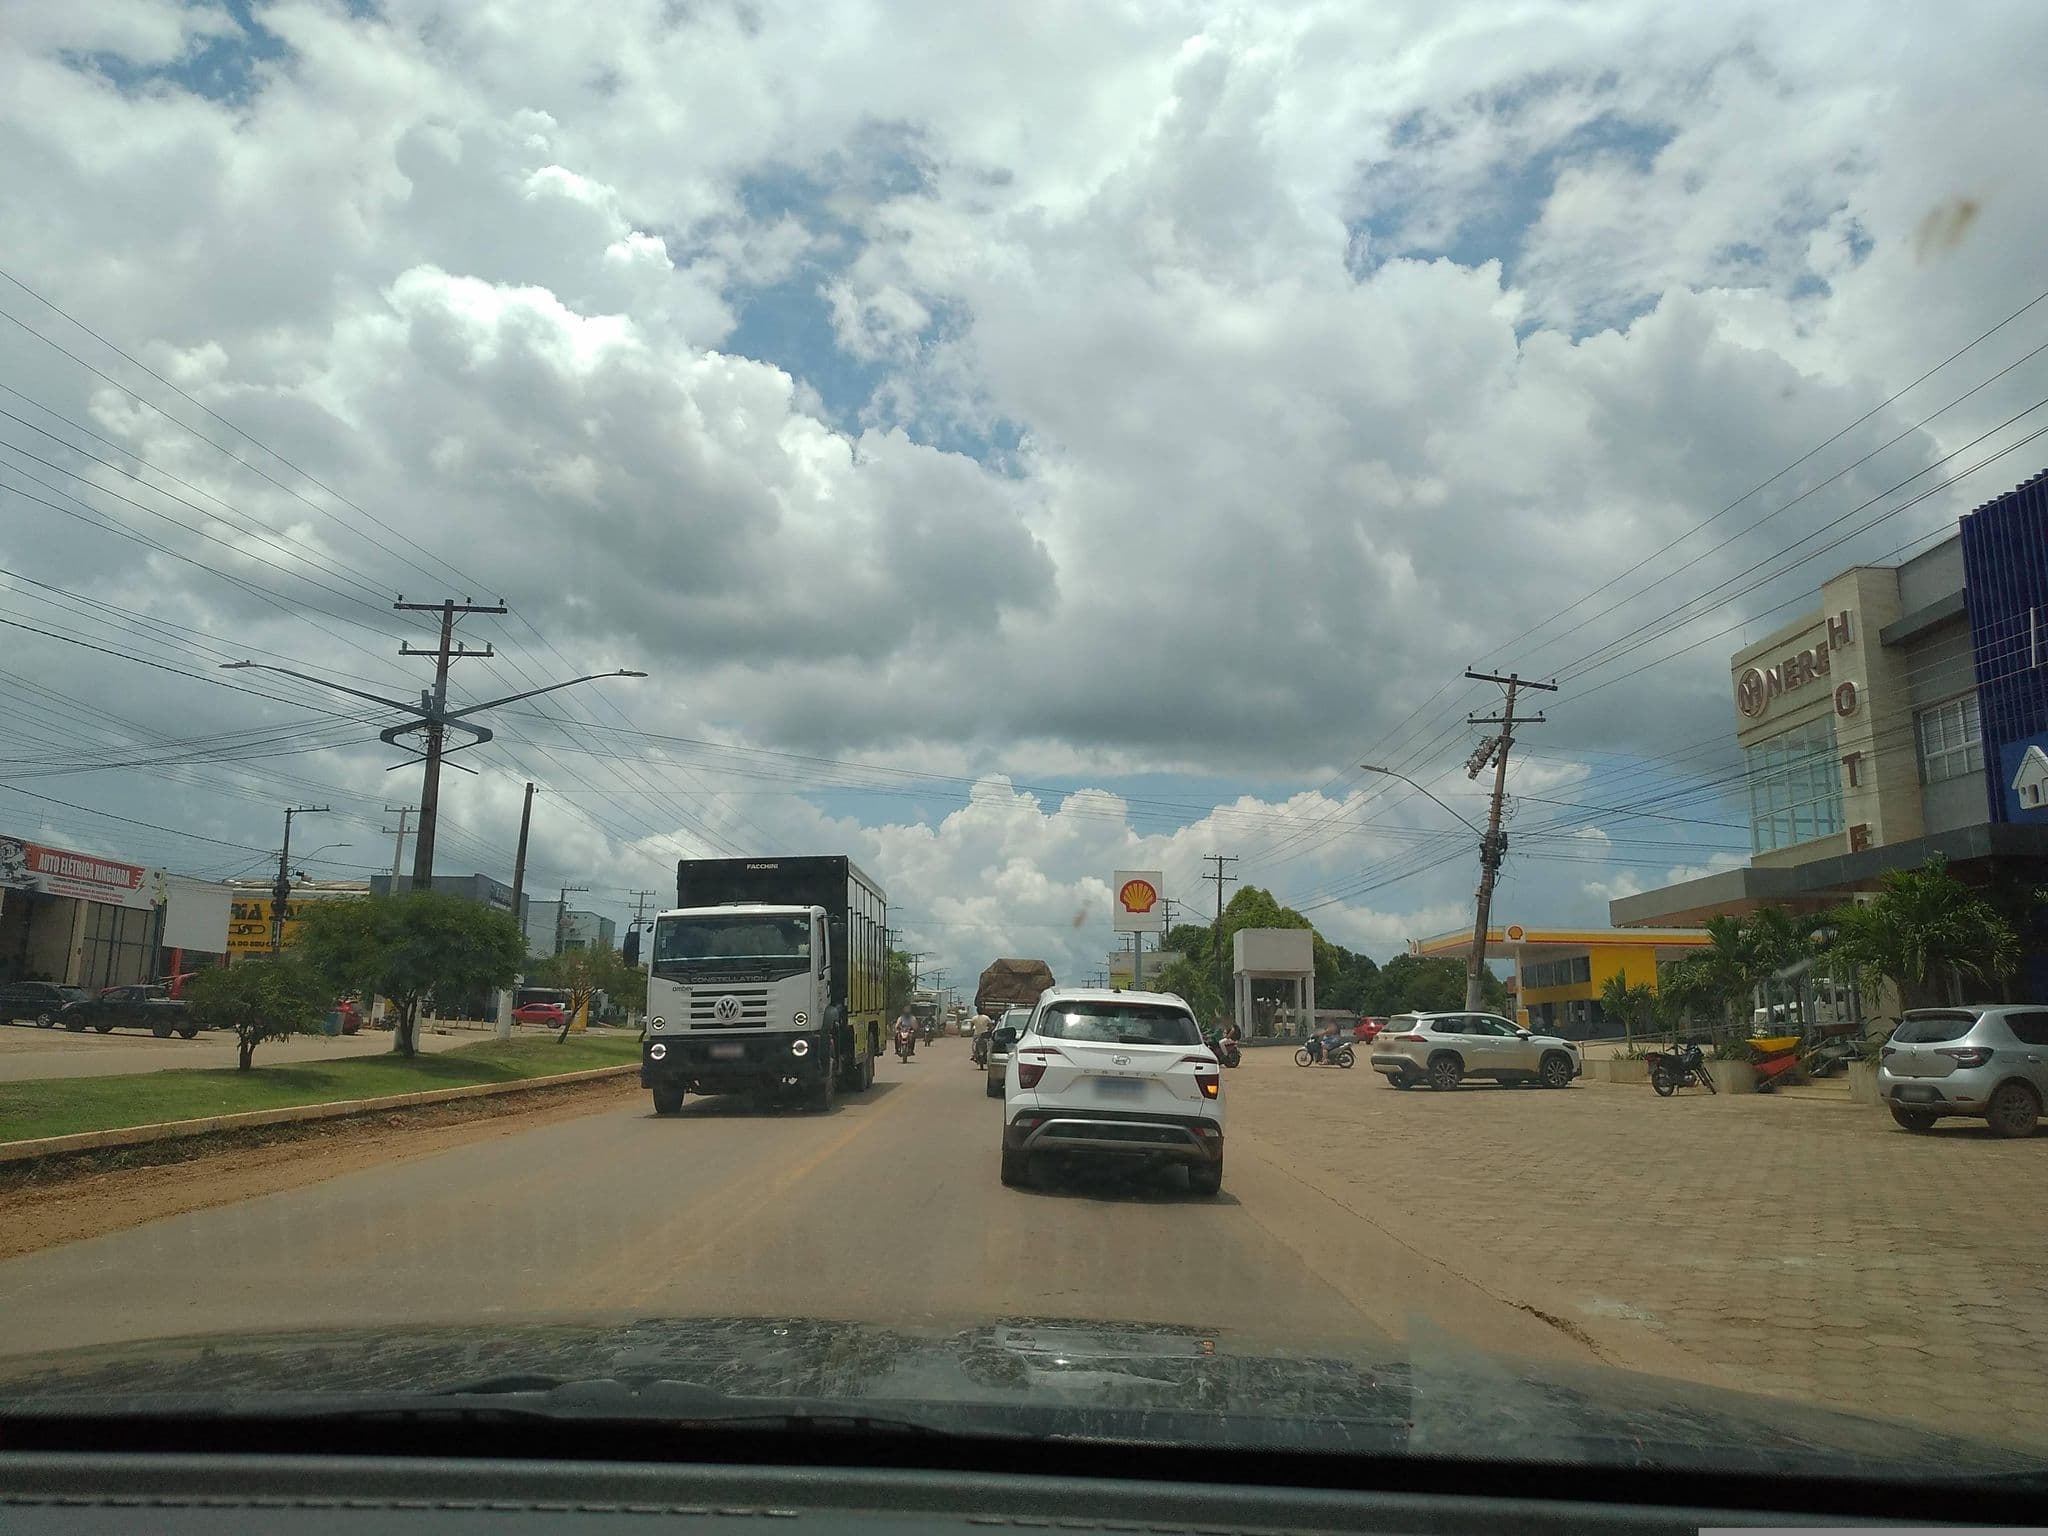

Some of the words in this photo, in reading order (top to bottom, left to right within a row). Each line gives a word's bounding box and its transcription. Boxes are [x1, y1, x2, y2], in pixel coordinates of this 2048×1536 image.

[38, 853, 60, 873] AUTO
[60, 856, 94, 880] ELÉTRICA
[94, 864, 131, 886] XINGUARA
[690, 975, 768, 983] CONSTELLATION
